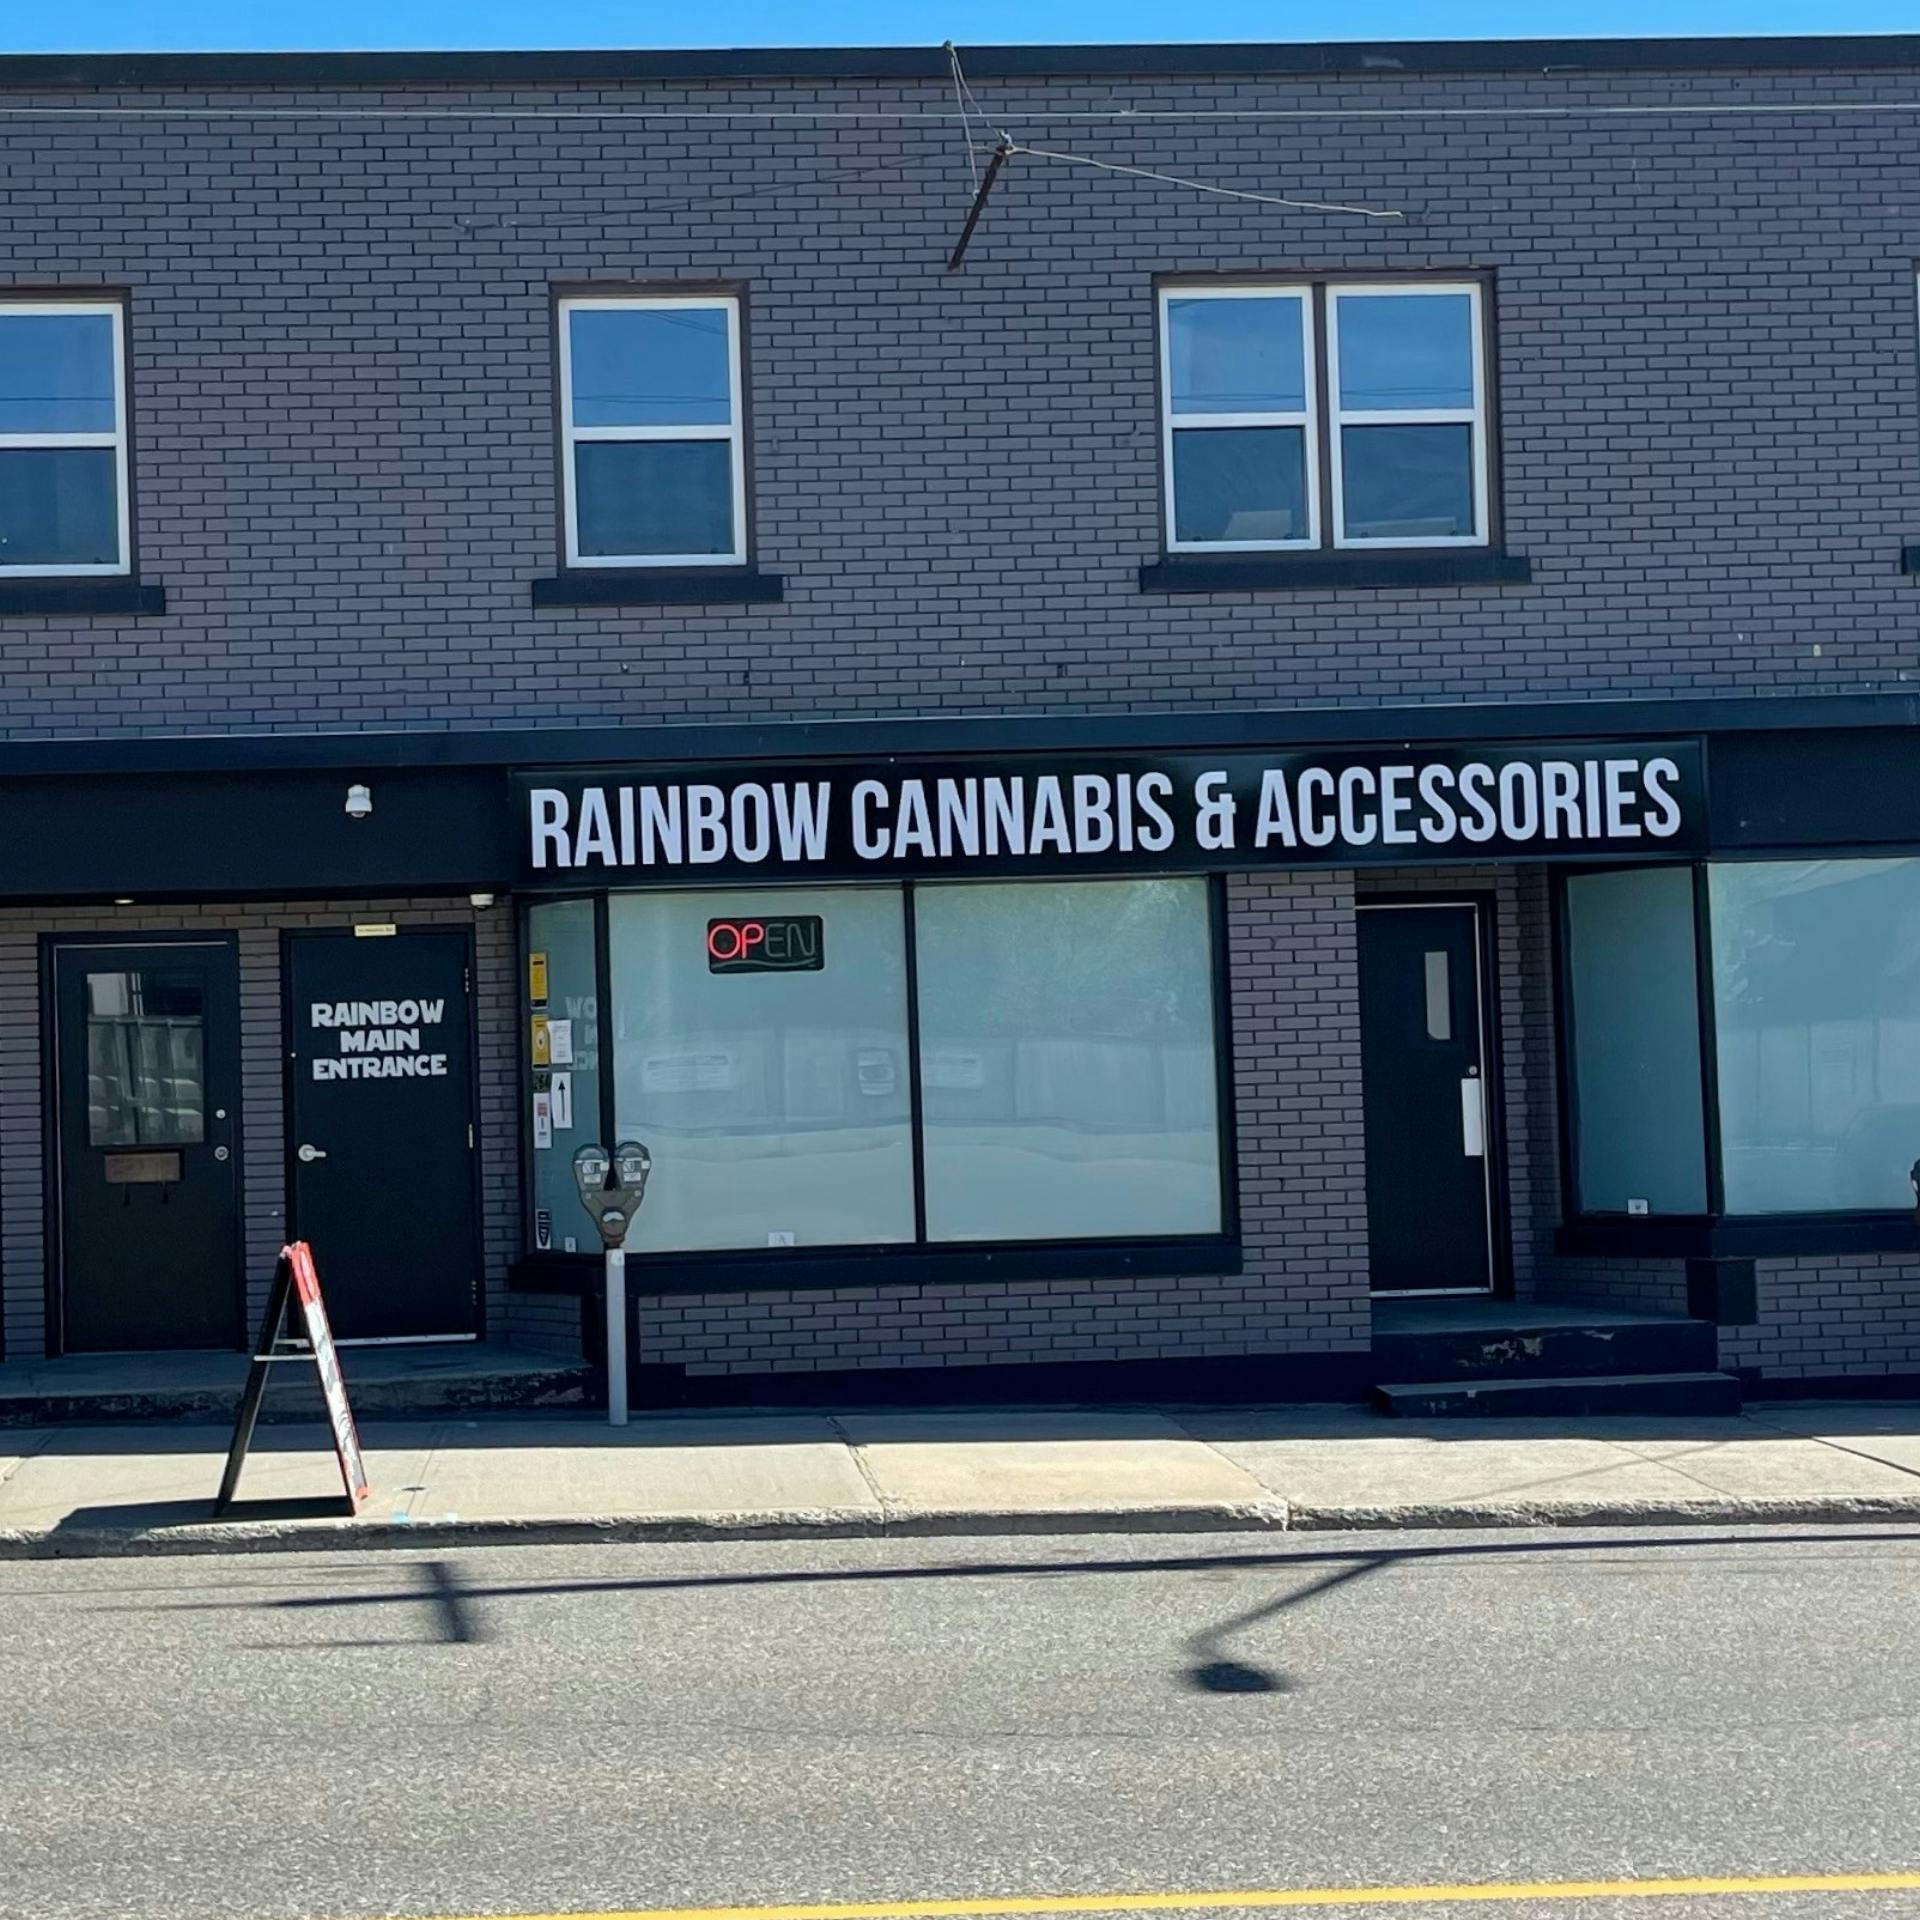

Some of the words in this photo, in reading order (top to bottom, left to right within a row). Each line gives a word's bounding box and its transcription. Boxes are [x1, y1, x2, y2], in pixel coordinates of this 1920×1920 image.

[530, 781, 831, 868] RAINBOW
[851, 774, 1174, 859] CANNABIS
[1195, 771, 1236, 849] &
[1254, 758, 1681, 848] ACCESSORIES
[708, 922, 816, 959] OPEN
[311, 999, 445, 1028] RAINBOW
[340, 1028, 420, 1053] MAIN
[312, 1054, 447, 1081] ENTRANCE
